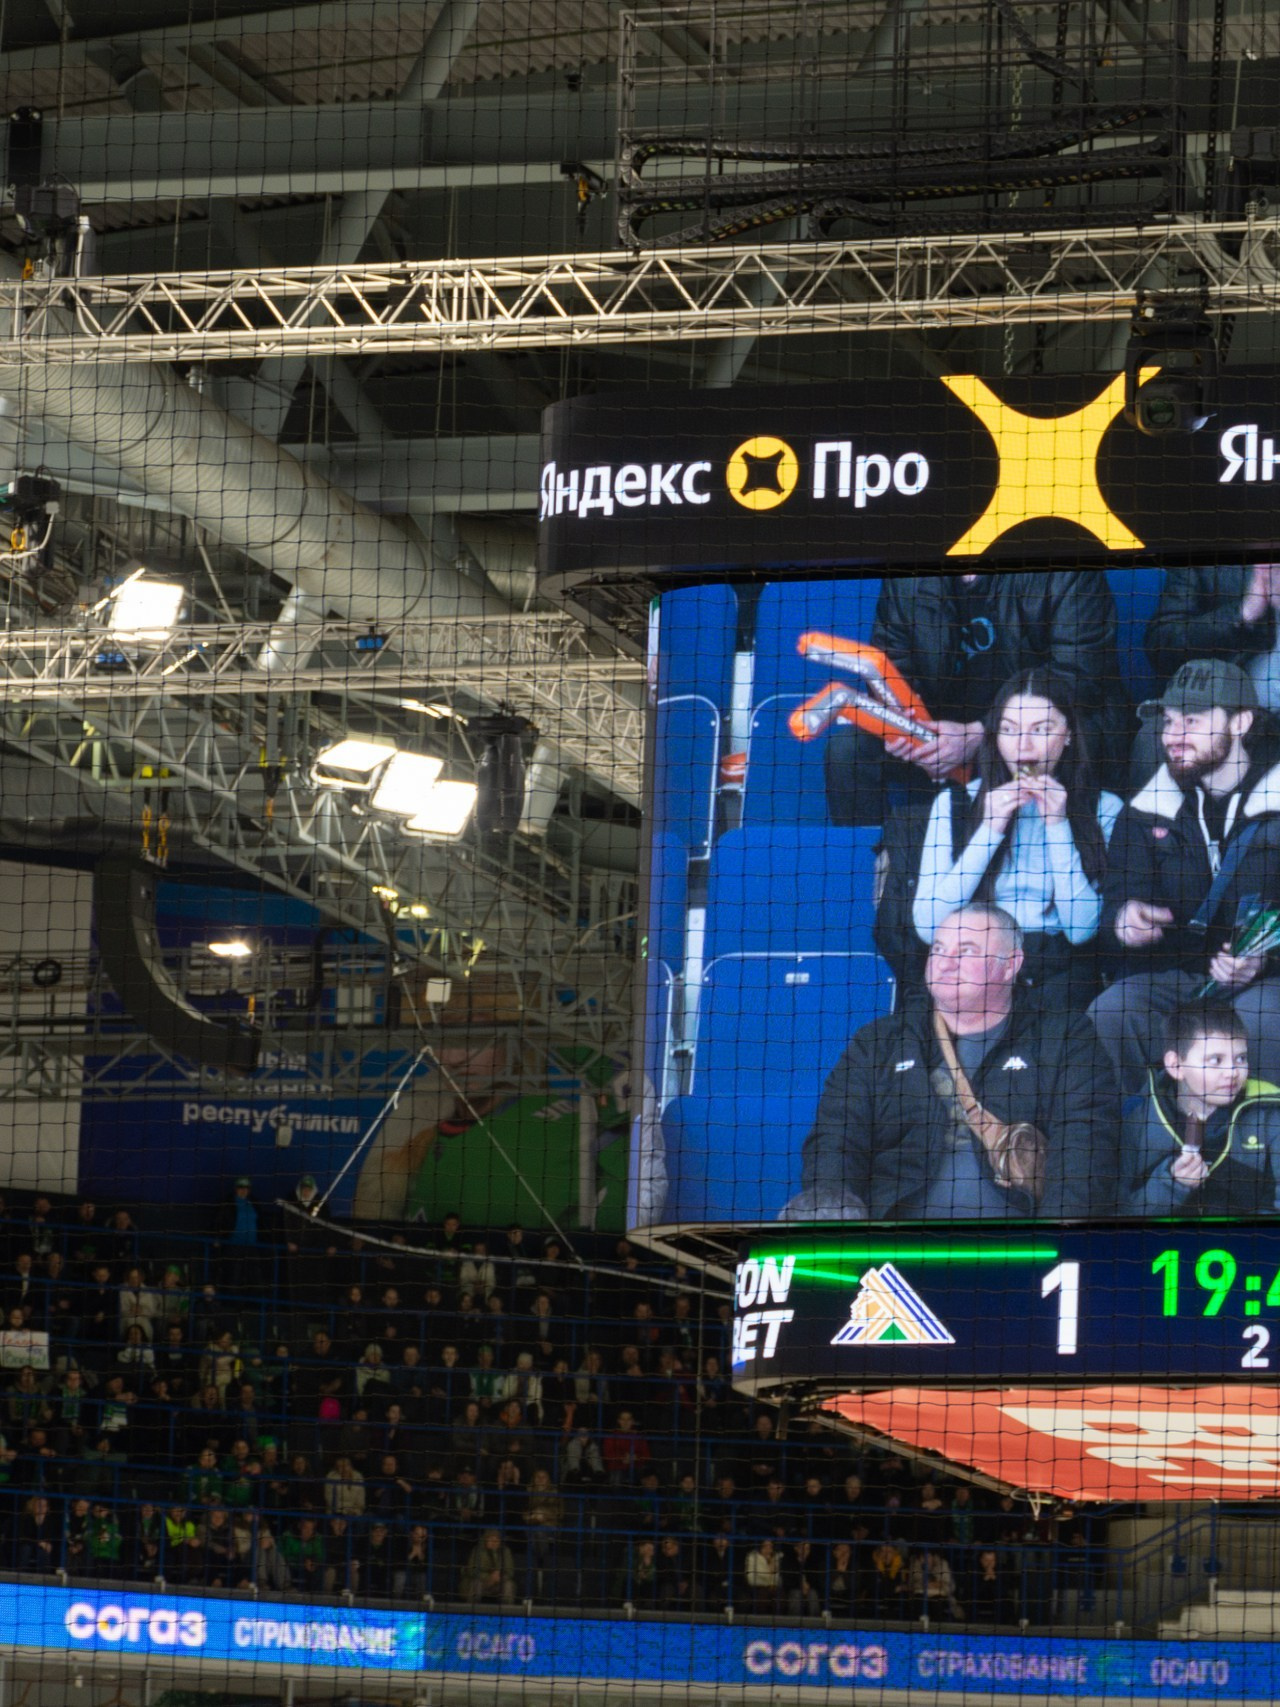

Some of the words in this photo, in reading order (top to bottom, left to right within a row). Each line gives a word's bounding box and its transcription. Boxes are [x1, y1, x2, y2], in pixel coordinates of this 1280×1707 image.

[539, 461, 712, 522] Яндекс
[812, 441, 930, 508] Про
[182, 1102, 360, 1134] республики
[1041, 1260, 1080, 1356] 1
[1240, 1324, 1271, 1368] 2
[233, 1616, 397, 1657] СТРАХОВАНИЕ
[456, 1631, 537, 1663] ОСАГО
[916, 1650, 1089, 1685] СТРАХОВАНИЕ
[1150, 1658, 1230, 1686] ОСАГО
